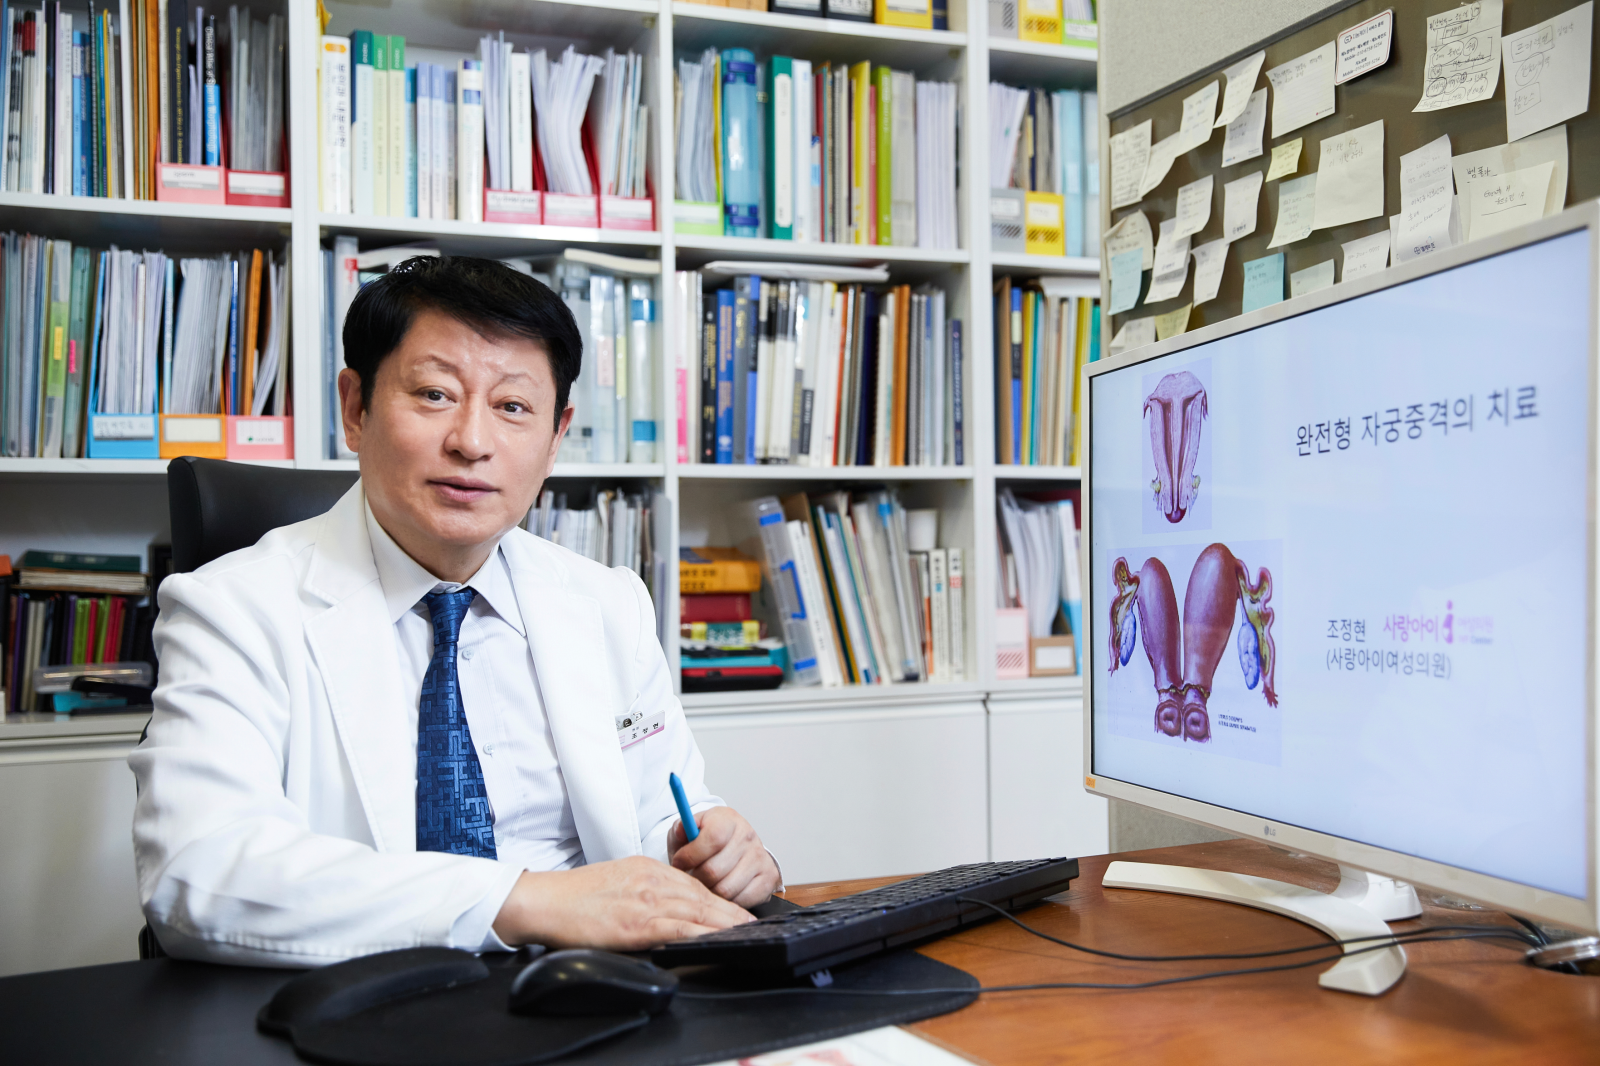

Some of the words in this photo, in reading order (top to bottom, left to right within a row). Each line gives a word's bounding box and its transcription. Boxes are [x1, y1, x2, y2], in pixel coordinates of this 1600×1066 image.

[1296, 416, 1351, 456] 완전형
[1361, 394, 1474, 447] 자궁중격의
[1487, 386, 1539, 427] 치료
[1326, 618, 1366, 643] 조정현
[1383, 614, 1438, 642] 사랑아이
[1326, 647, 1452, 680] (사랑아이여성의원)
